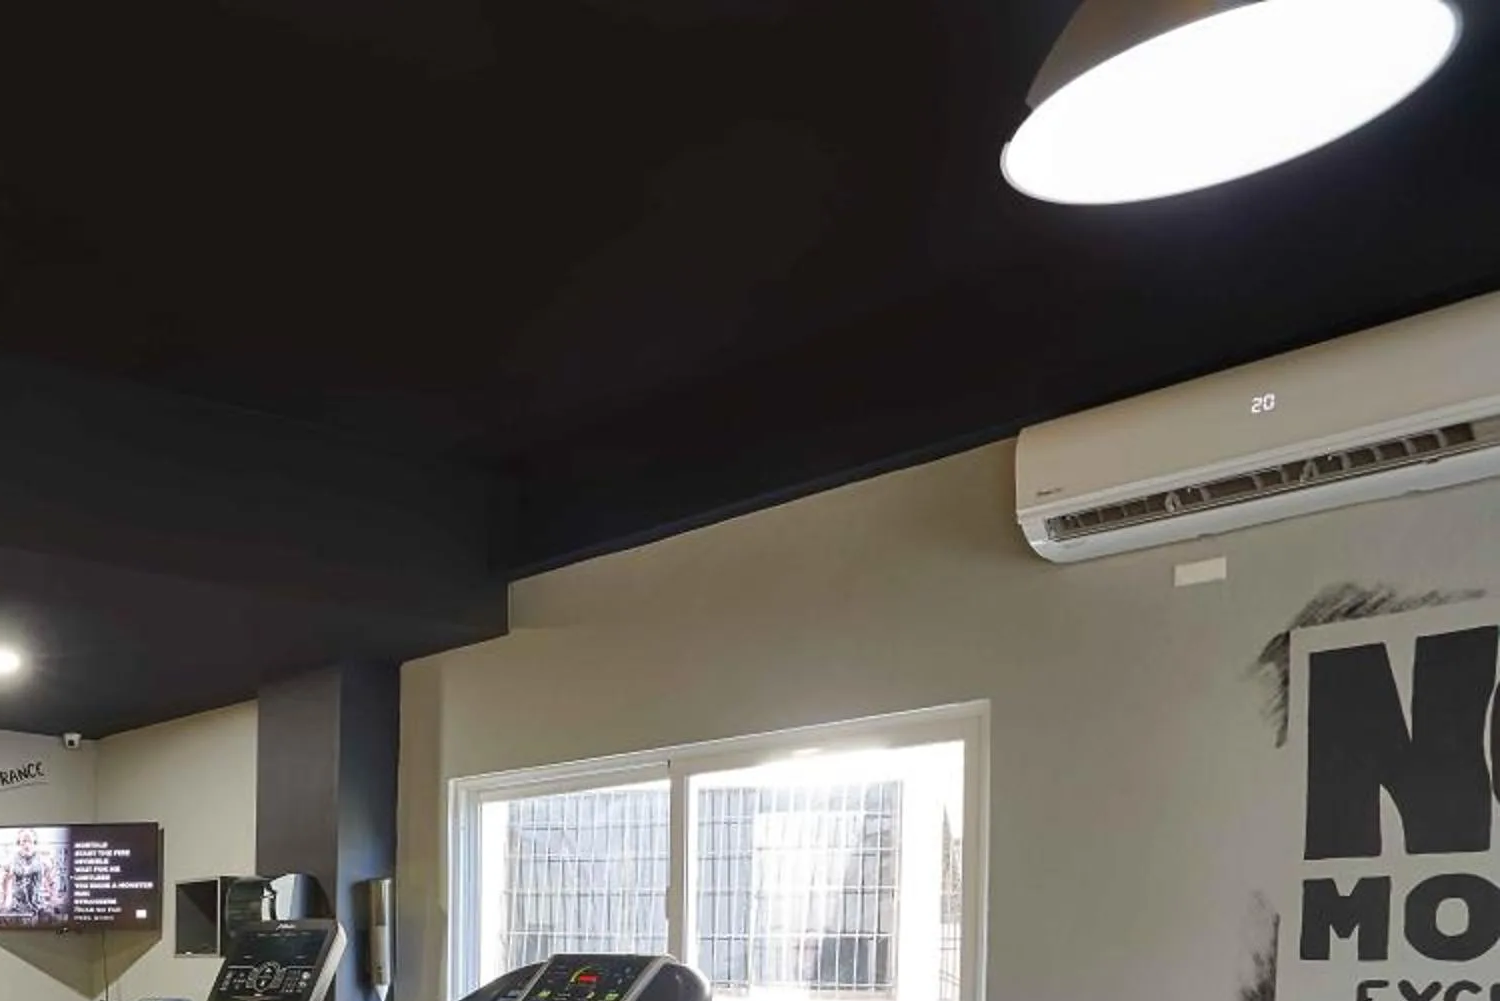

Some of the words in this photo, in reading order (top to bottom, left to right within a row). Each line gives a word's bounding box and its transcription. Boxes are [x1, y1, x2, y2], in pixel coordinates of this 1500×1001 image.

[1251, 394, 1275, 412] 20
[1304, 625, 1500, 860] N
[1300, 873, 1500, 962] MO
